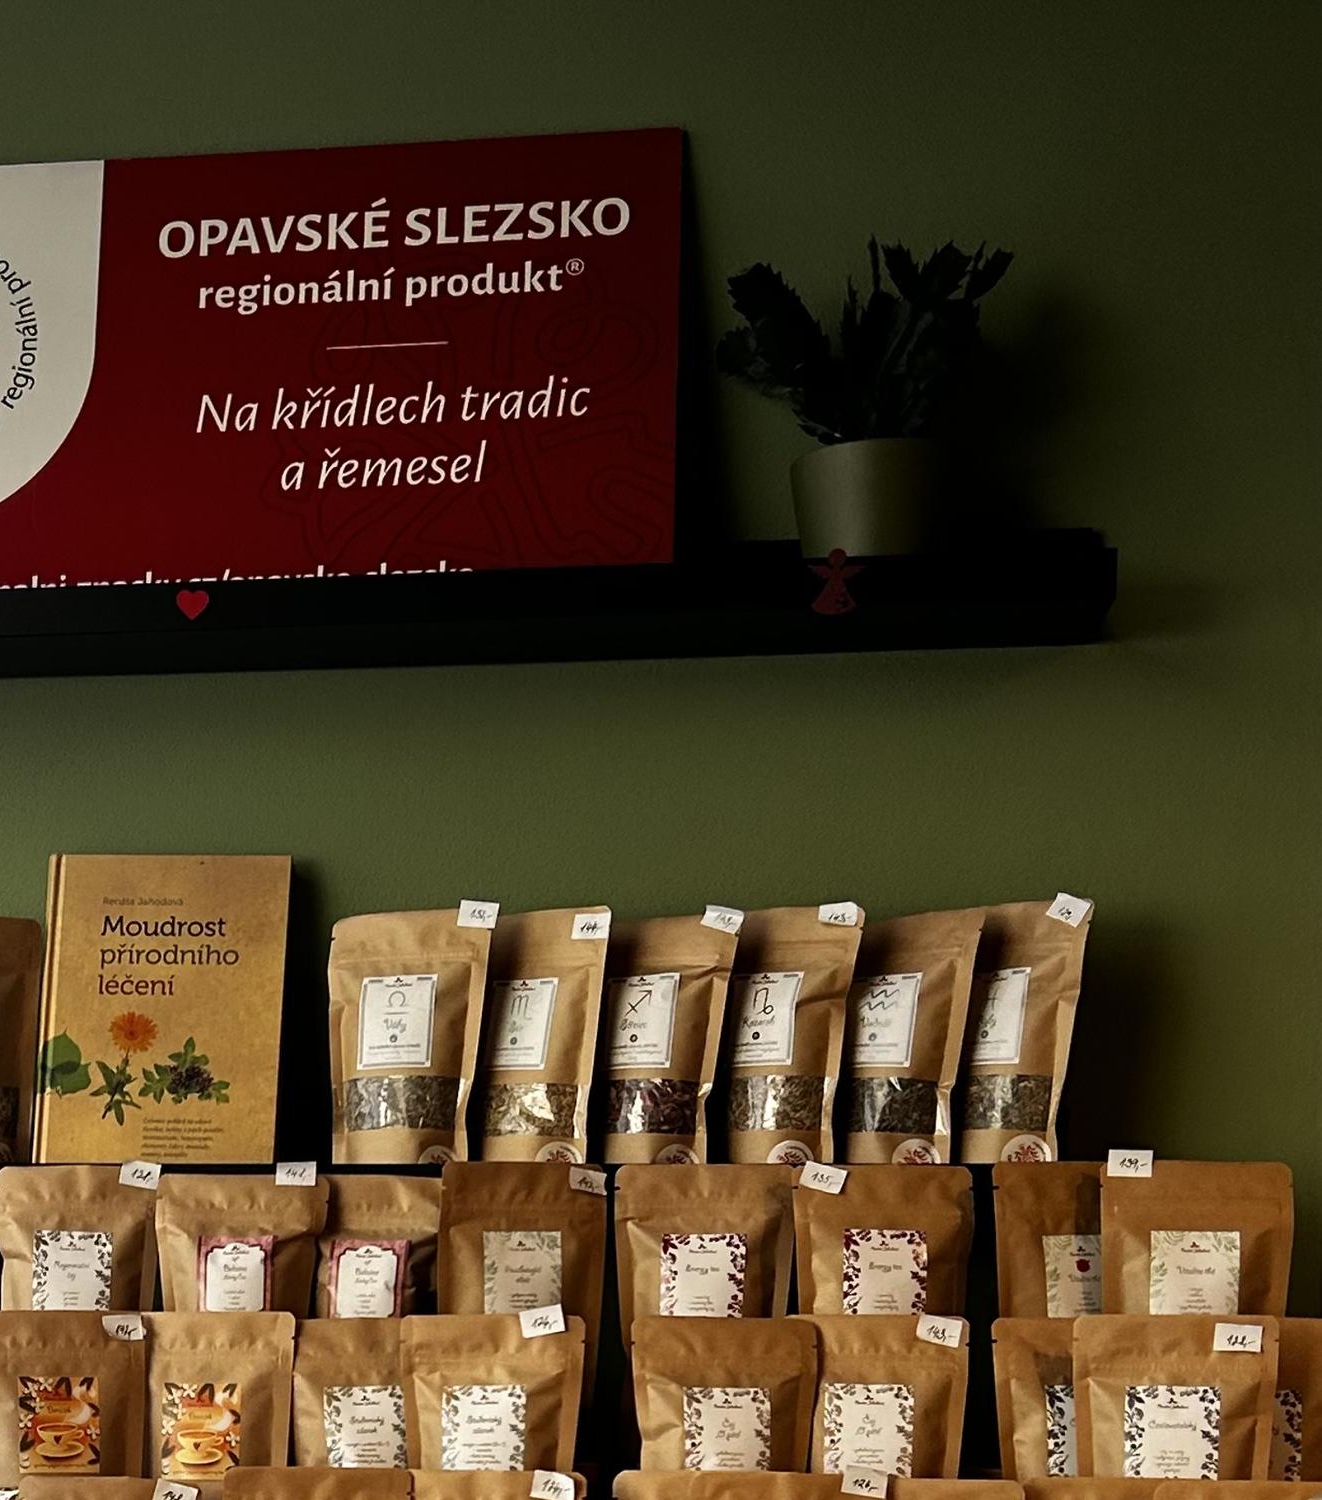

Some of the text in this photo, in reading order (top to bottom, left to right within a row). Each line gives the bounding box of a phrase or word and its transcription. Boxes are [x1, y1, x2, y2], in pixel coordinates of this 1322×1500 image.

[158, 197, 630, 258] OPAVSKÉ SLEZSKO
[198, 266, 393, 315] regionální
[0, 296, 38, 410] regionální
[196, 375, 590, 433] Na křídlech tradic
[280, 440, 487, 491] a řemesel
[100, 915, 226, 937] Moudrost
[100, 943, 240, 970] přírodního
[98, 975, 175, 996] léčení
